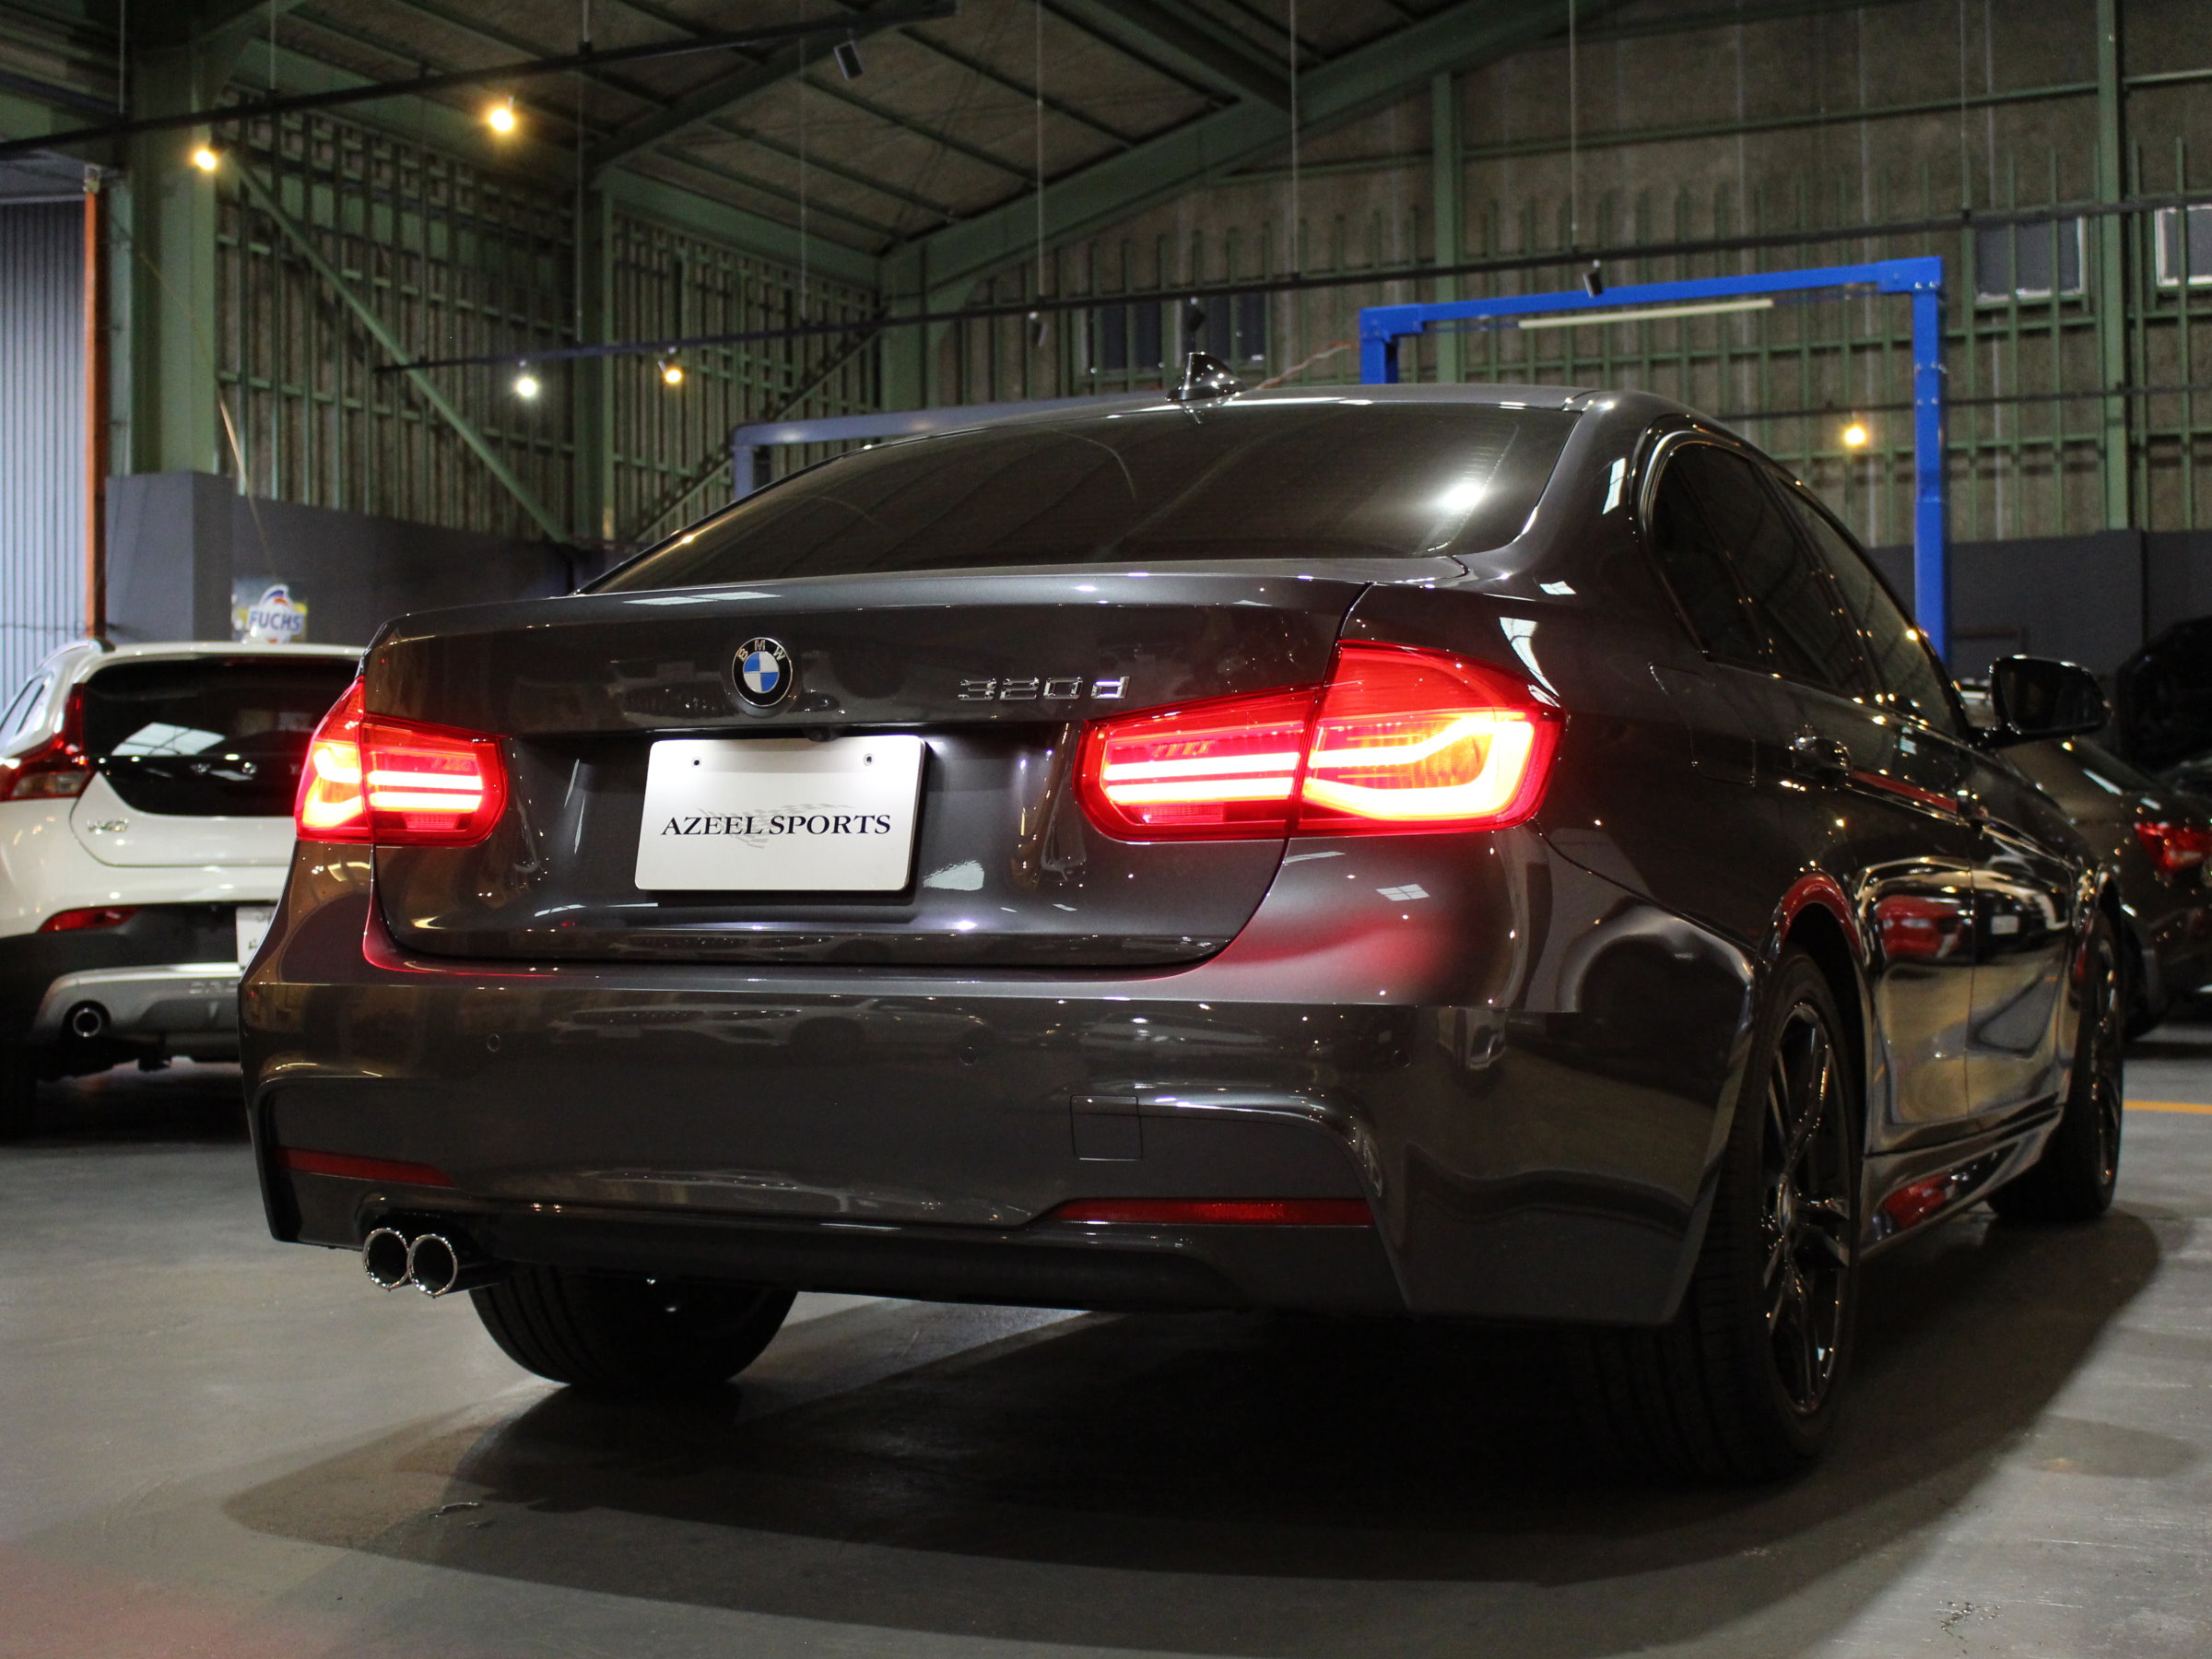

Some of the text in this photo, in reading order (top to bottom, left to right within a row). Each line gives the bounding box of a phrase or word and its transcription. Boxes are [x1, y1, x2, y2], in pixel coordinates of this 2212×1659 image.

[249, 610, 302, 631] FUCHS
[736, 640, 786, 663] BMW
[660, 814, 891, 836] AZEEL SPORTS
